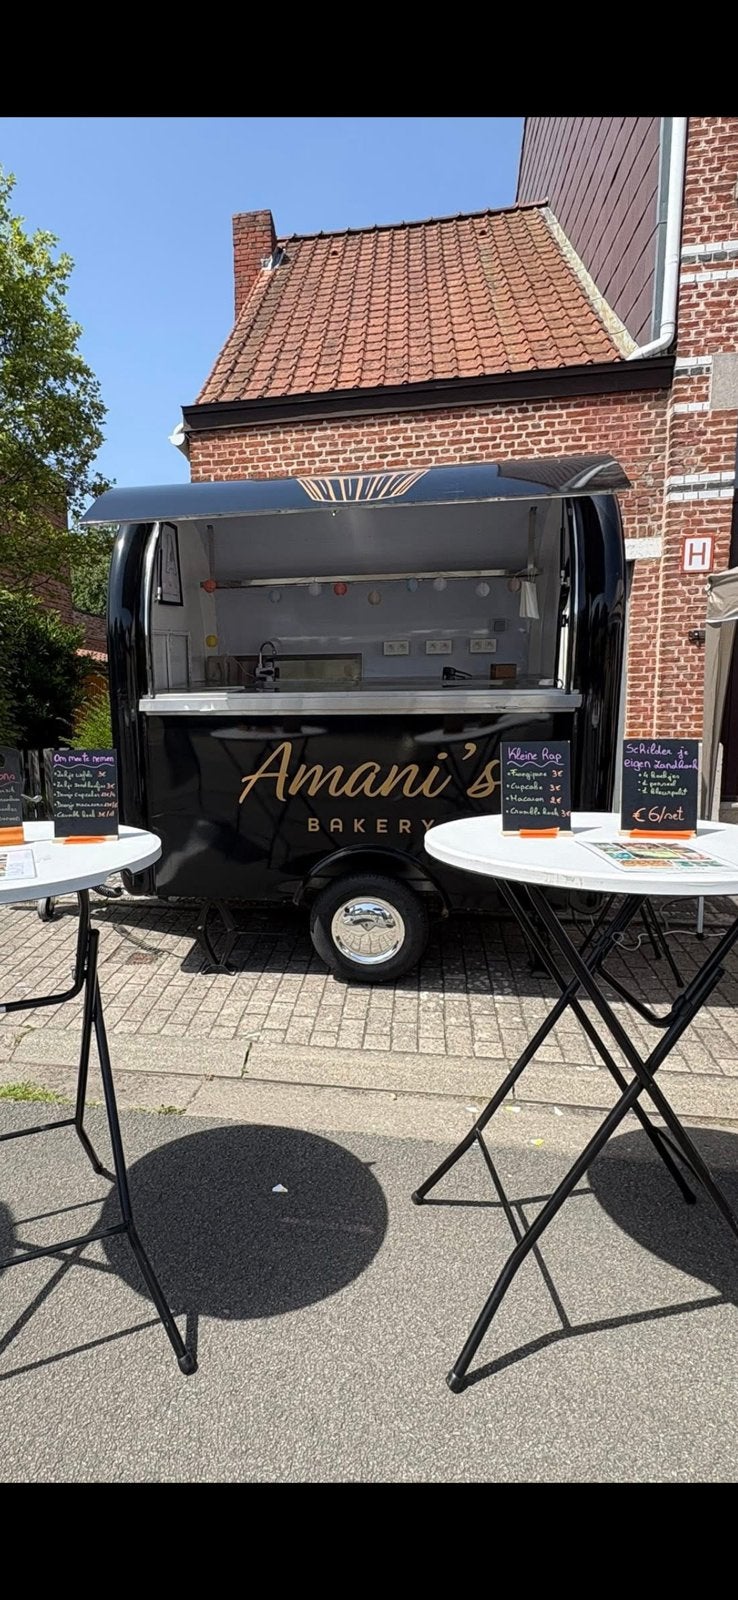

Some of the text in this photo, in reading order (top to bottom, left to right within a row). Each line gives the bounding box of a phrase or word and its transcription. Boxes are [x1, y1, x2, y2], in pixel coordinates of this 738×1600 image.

[689, 542, 706, 566] H
[508, 747, 537, 760] Kleine
[626, 743, 688, 759] Schilder je
[54, 754, 66, 763] Om
[624, 760, 651, 772] eigen
[239, 742, 501, 804] Amani's
[552, 769, 564, 777] 3€
[550, 797, 561, 805] 2€
[308, 818, 435, 834] BAKERY
